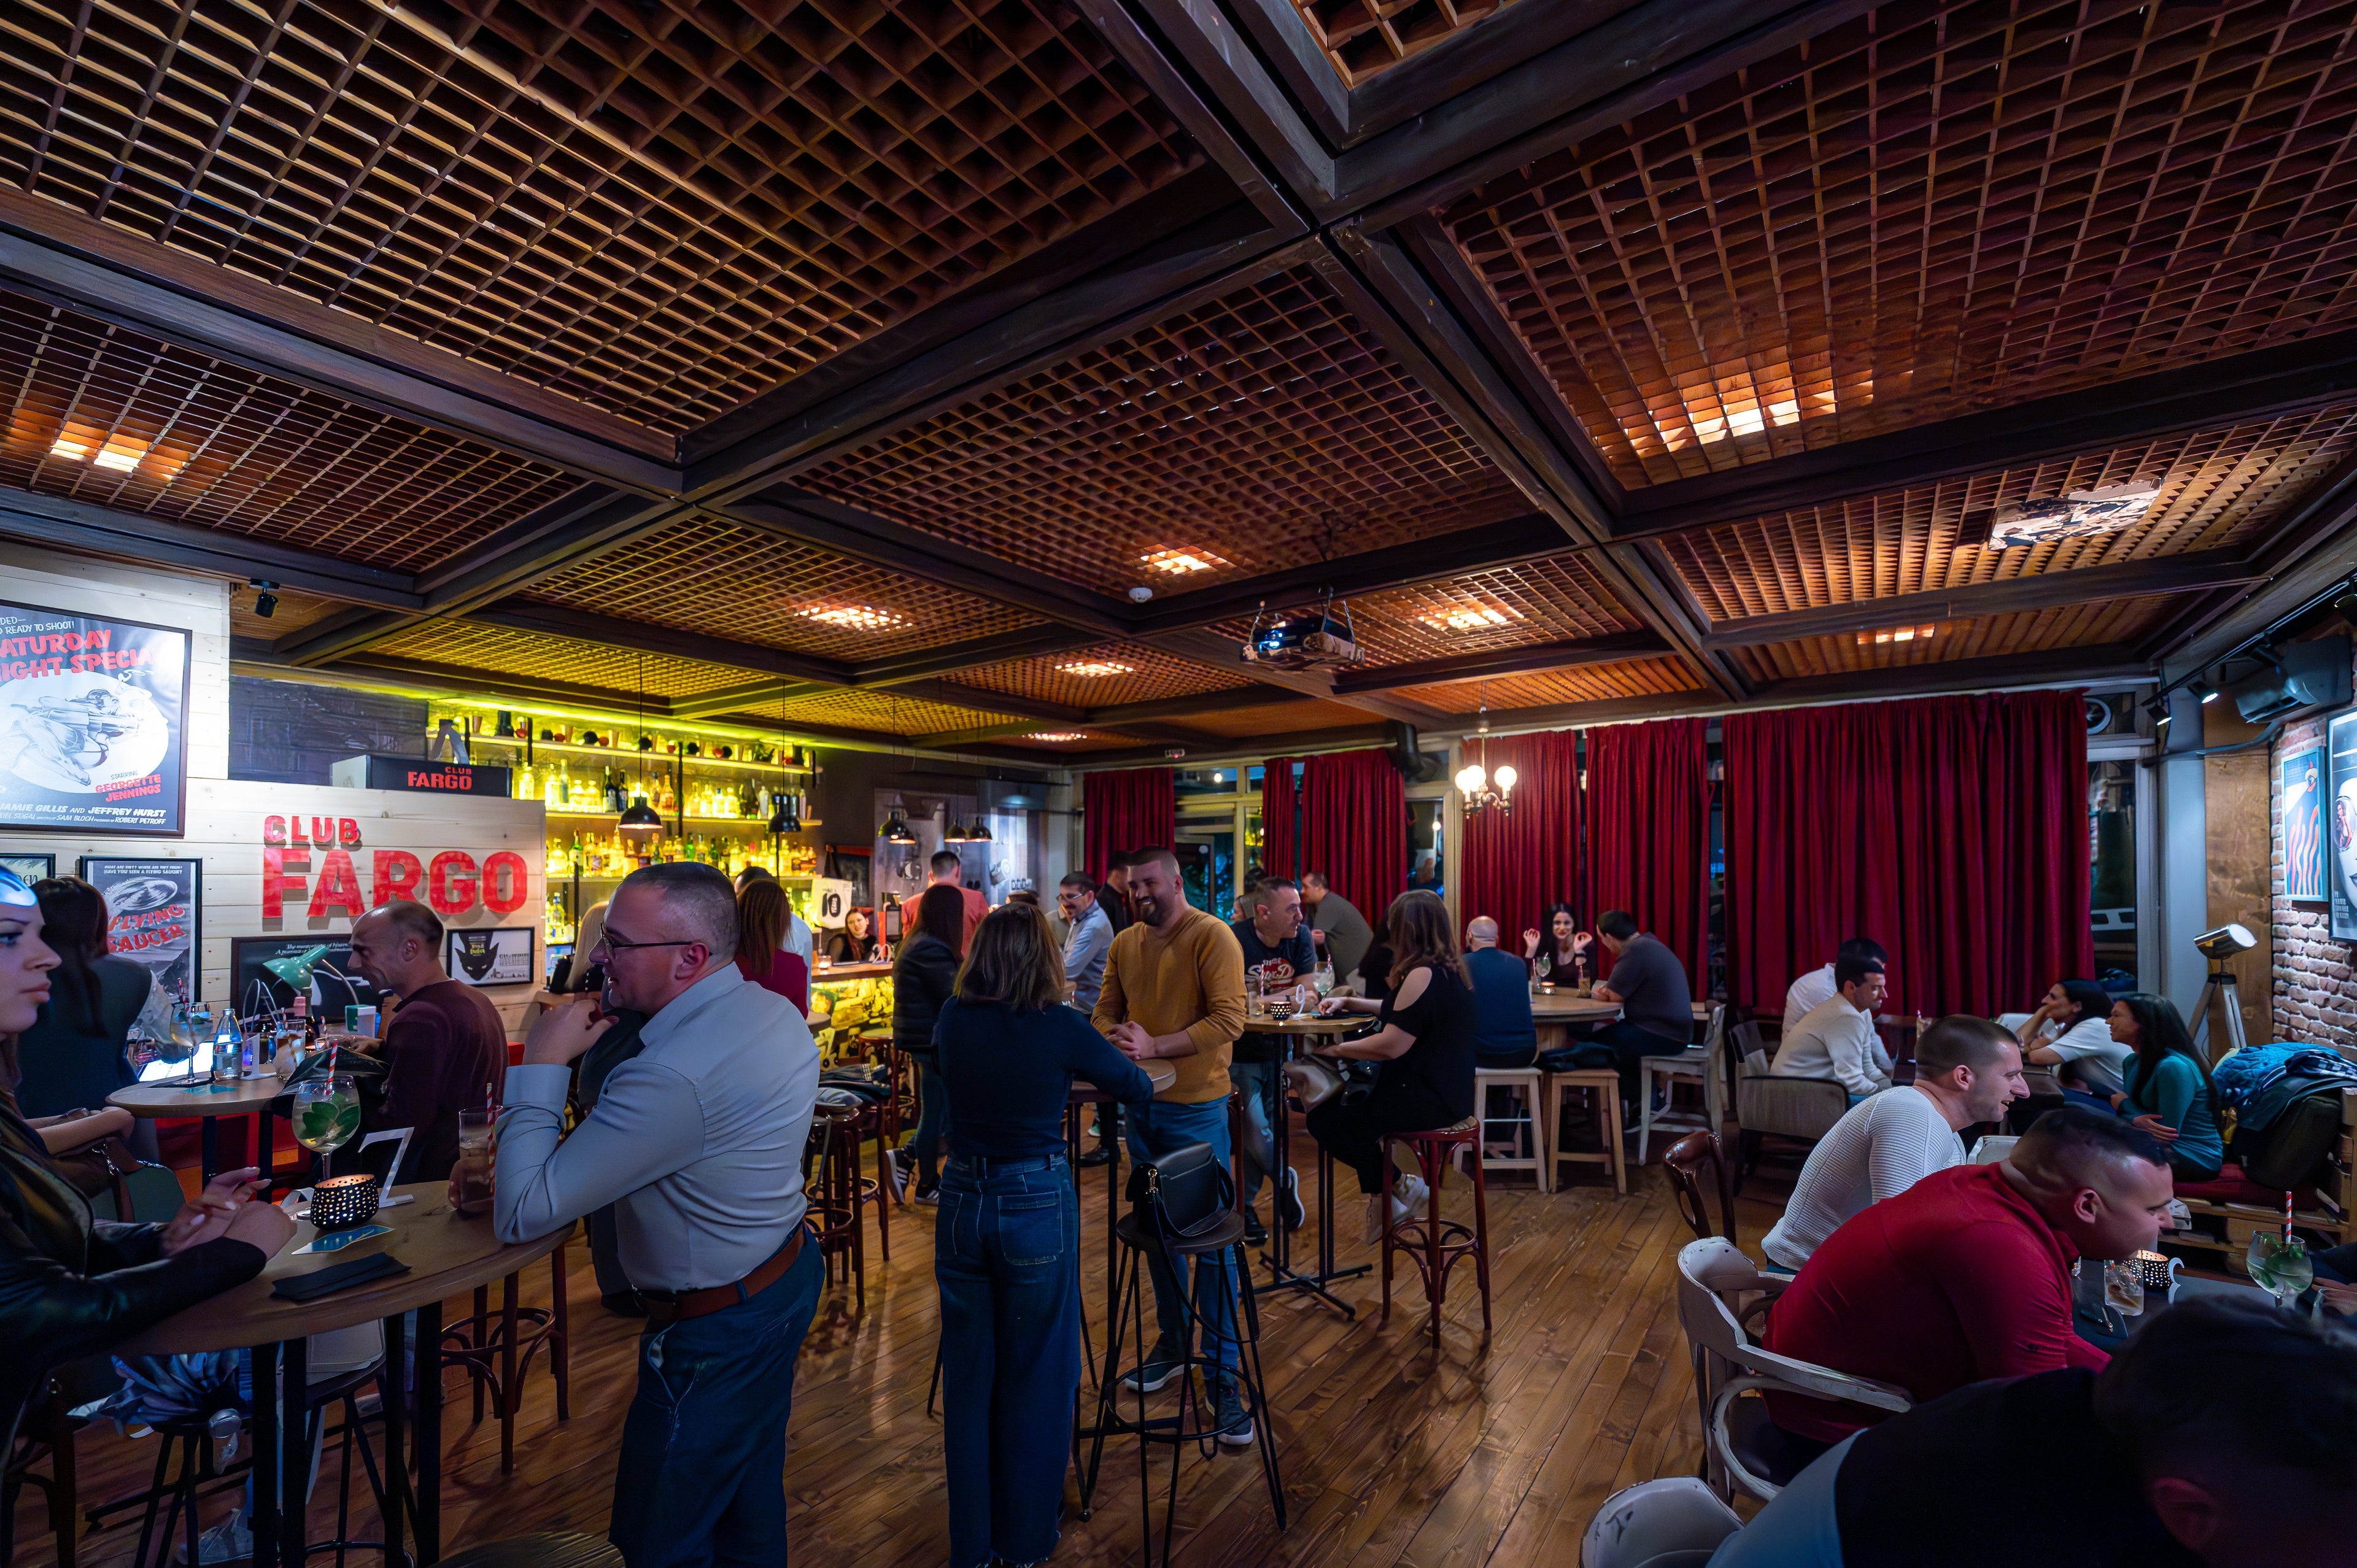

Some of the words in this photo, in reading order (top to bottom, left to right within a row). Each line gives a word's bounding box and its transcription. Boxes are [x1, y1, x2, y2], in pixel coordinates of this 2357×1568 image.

[4, 624, 32, 635] READY
[46, 621, 75, 631] SHOOT!
[0, 629, 111, 658] ATURDAY
[0, 657, 63, 682] IGHT
[70, 648, 153, 673] SPECIA
[110, 771, 138, 780] STARRING
[408, 771, 472, 790] FARGO
[445, 766, 472, 774] CLUB
[95, 773, 161, 794] GEORGETTE
[106, 784, 161, 802] JENNINGS
[35, 804, 68, 813] GILLIS
[88, 807, 132, 816] JEFFREY
[133, 809, 166, 817] HURST
[264, 816, 359, 843] CLUB
[263, 848, 527, 918] FARGO
[822, 893, 841, 917] 10
[107, 904, 184, 932] FLYING
[107, 924, 186, 953] SAUCER
